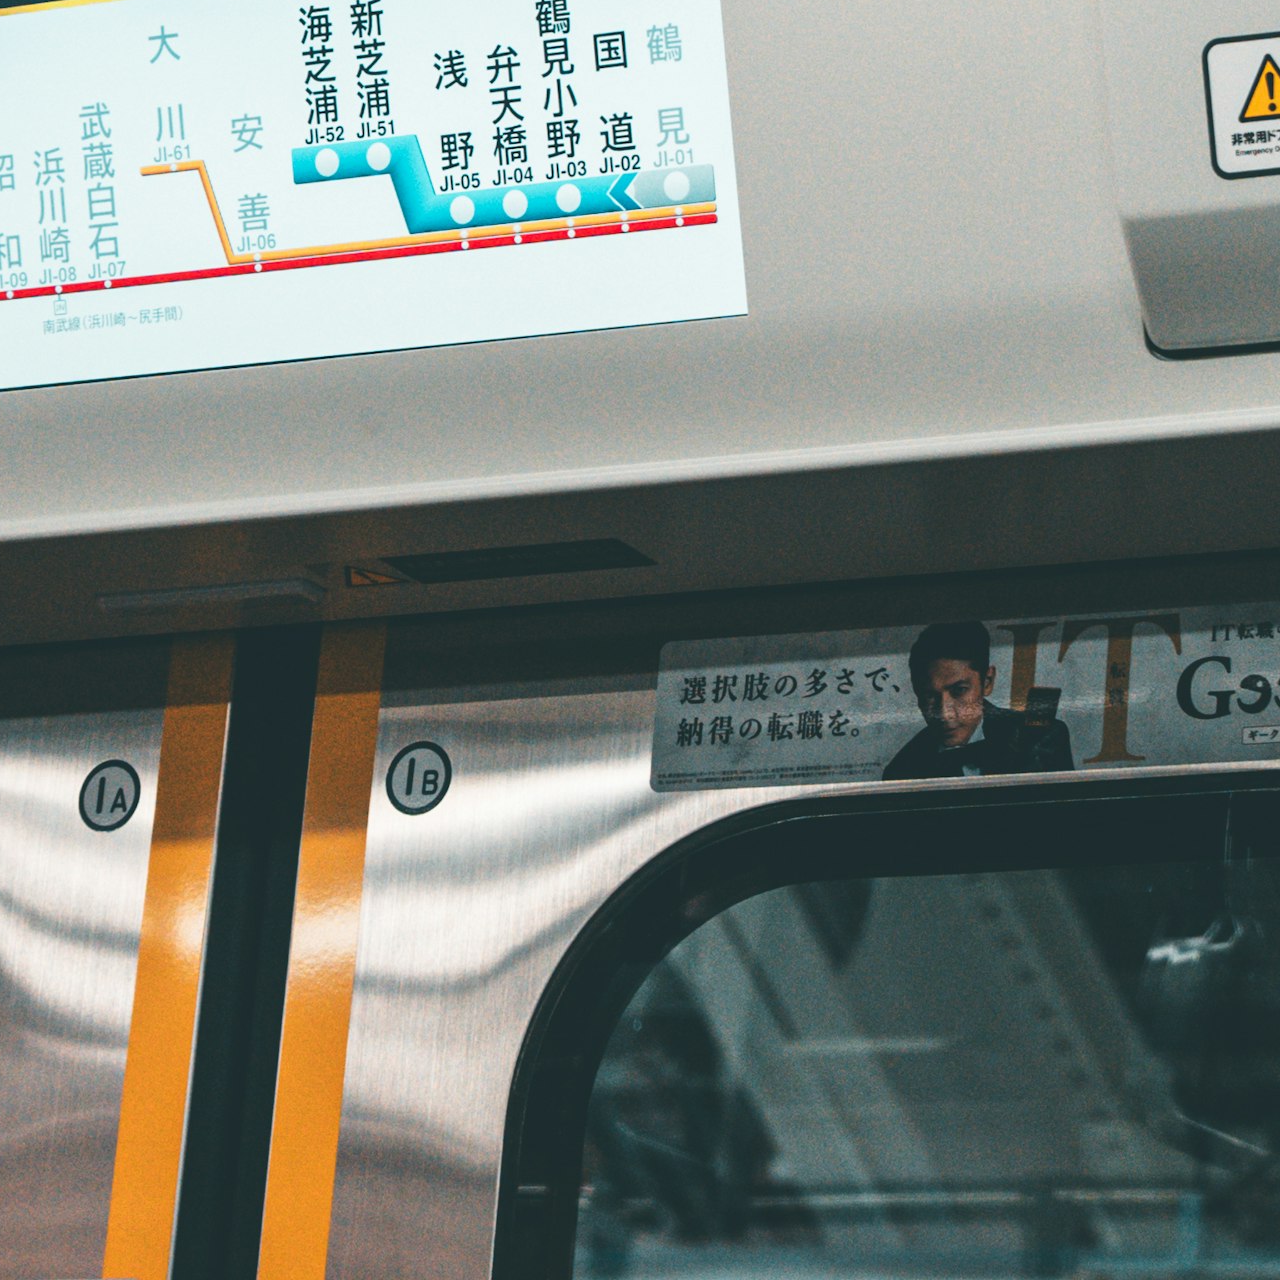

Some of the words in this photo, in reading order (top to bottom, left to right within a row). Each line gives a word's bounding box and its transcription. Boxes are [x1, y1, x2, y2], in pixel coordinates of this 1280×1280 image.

[297, 4, 340, 125] 海芝浦
[148, 25, 186, 142] 大川
[592, 30, 638, 155] 国道
[644, 21, 692, 150] 鶴見
[432, 48, 476, 173] 浅野
[486, 43, 529, 168] 弁天橋
[305, 126, 346, 145] JI-52
[356, 120, 397, 140] JI-51
[153, 144, 192, 164] JI-61
[652, 148, 697, 169] JI-01
[1235, 146, 1274, 157] Emergency
[230, 112, 271, 234] 安善
[544, 160, 588, 181] JI-03
[599, 154, 642, 175] JI-02
[78, 101, 121, 261] 武蔵白石
[439, 172, 481, 194] JI-05
[491, 166, 534, 187] JI-04
[32, 146, 72, 266] 浜川崎
[236, 234, 277, 254] JI-06
[38, 267, 78, 287] JI-08
[87, 261, 127, 281] JI-07
[680, 666, 901, 706] 選択肢の多さで、
[675, 709, 861, 748] 納得の転職を。
